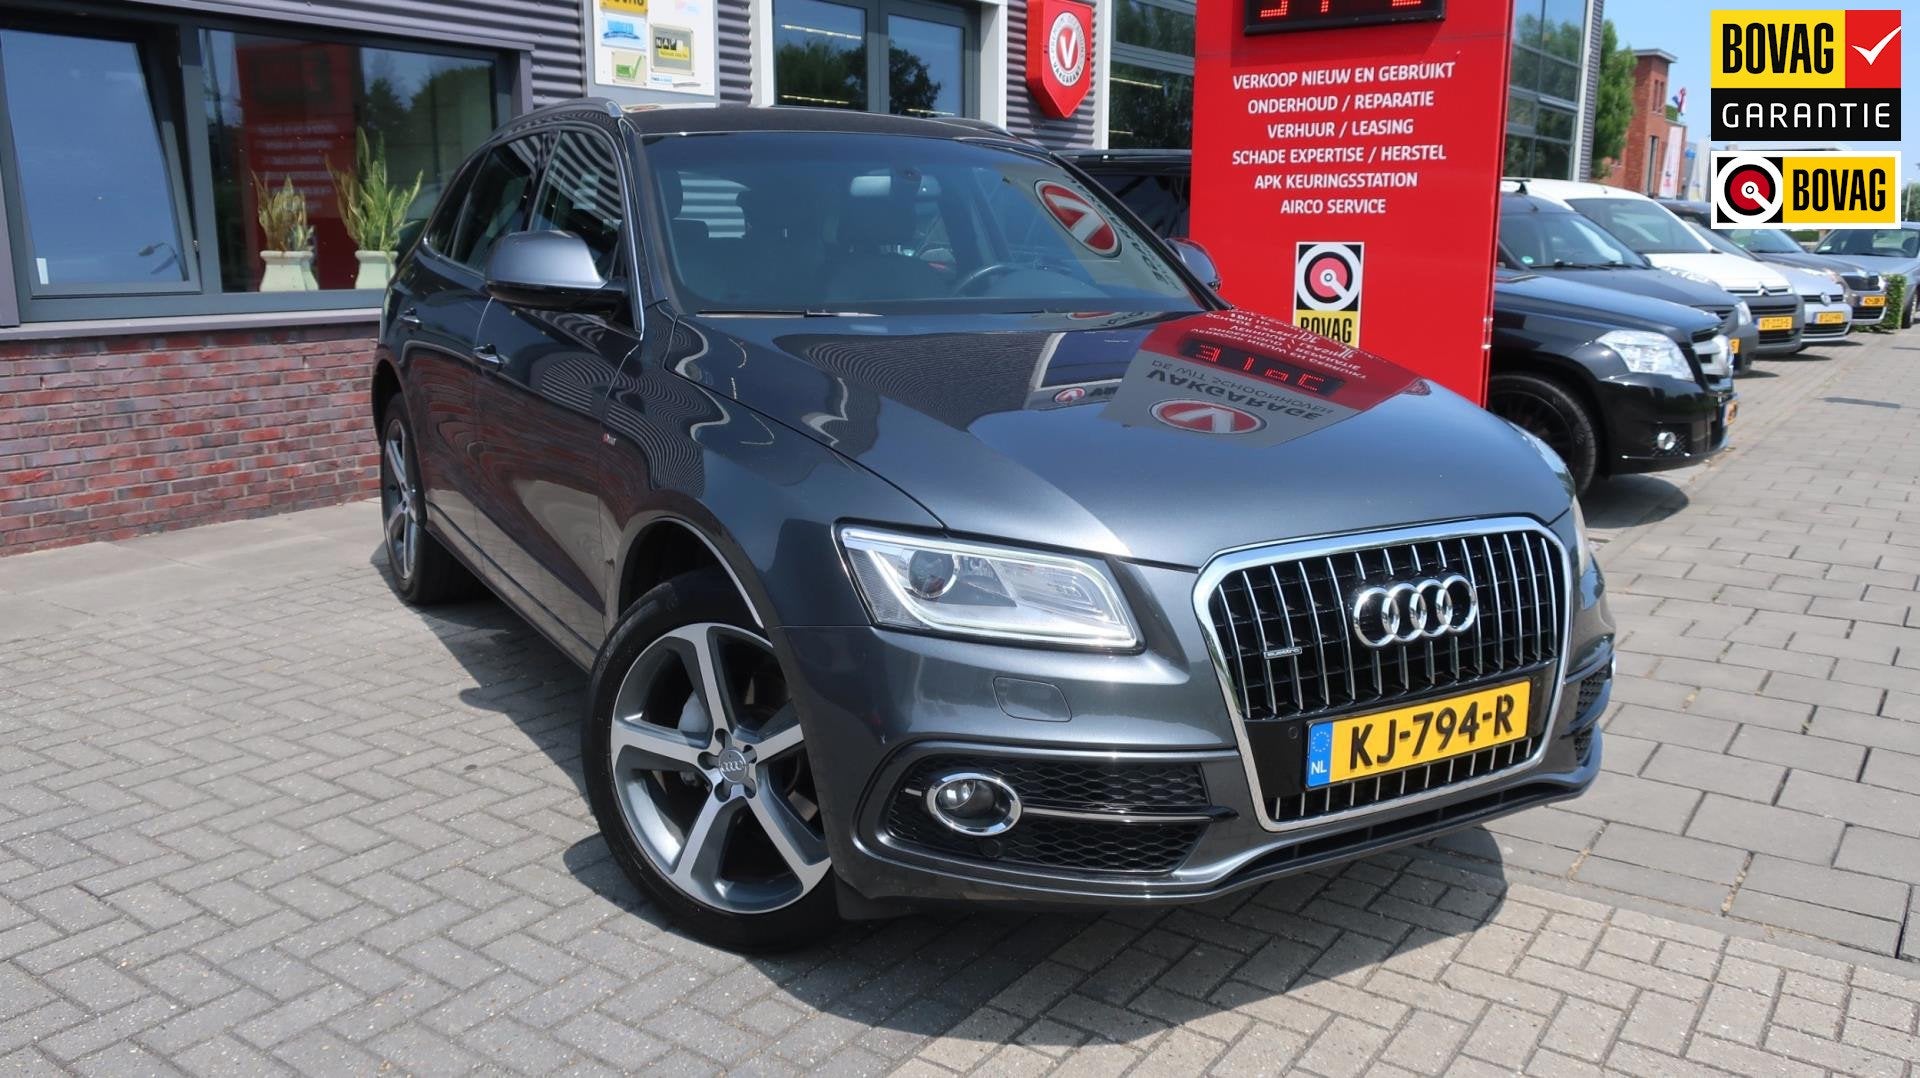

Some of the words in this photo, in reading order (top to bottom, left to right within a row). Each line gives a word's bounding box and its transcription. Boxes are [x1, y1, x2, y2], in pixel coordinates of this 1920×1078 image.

[1232, 72, 1298, 90] VERKOOP
[1301, 68, 1351, 86] NIEUW
[1354, 66, 1375, 83] EN
[1378, 62, 1455, 82] GEBRUIKT
[1247, 95, 1338, 114] ONDERHOUD
[1341, 95, 1350, 112] /
[1354, 90, 1435, 110] REPARATIE
[1267, 121, 1335, 139] VERHUUR
[1338, 121, 1348, 138] /
[1352, 118, 1414, 136] LEASING
[1232, 149, 1286, 165] SCHADE
[1290, 147, 1364, 164] EXPERTISE
[1367, 146, 1377, 164] /
[1380, 144, 1447, 162] HERSTEL
[1254, 174, 1282, 190] APK
[1286, 172, 1418, 189] KEURINGSSTATION
[1280, 199, 1324, 214] AIRCO
[1327, 198, 1387, 214] SERVICE
[1350, 694, 1514, 769] KJ-794-R
[1311, 759, 1328, 775] NL
